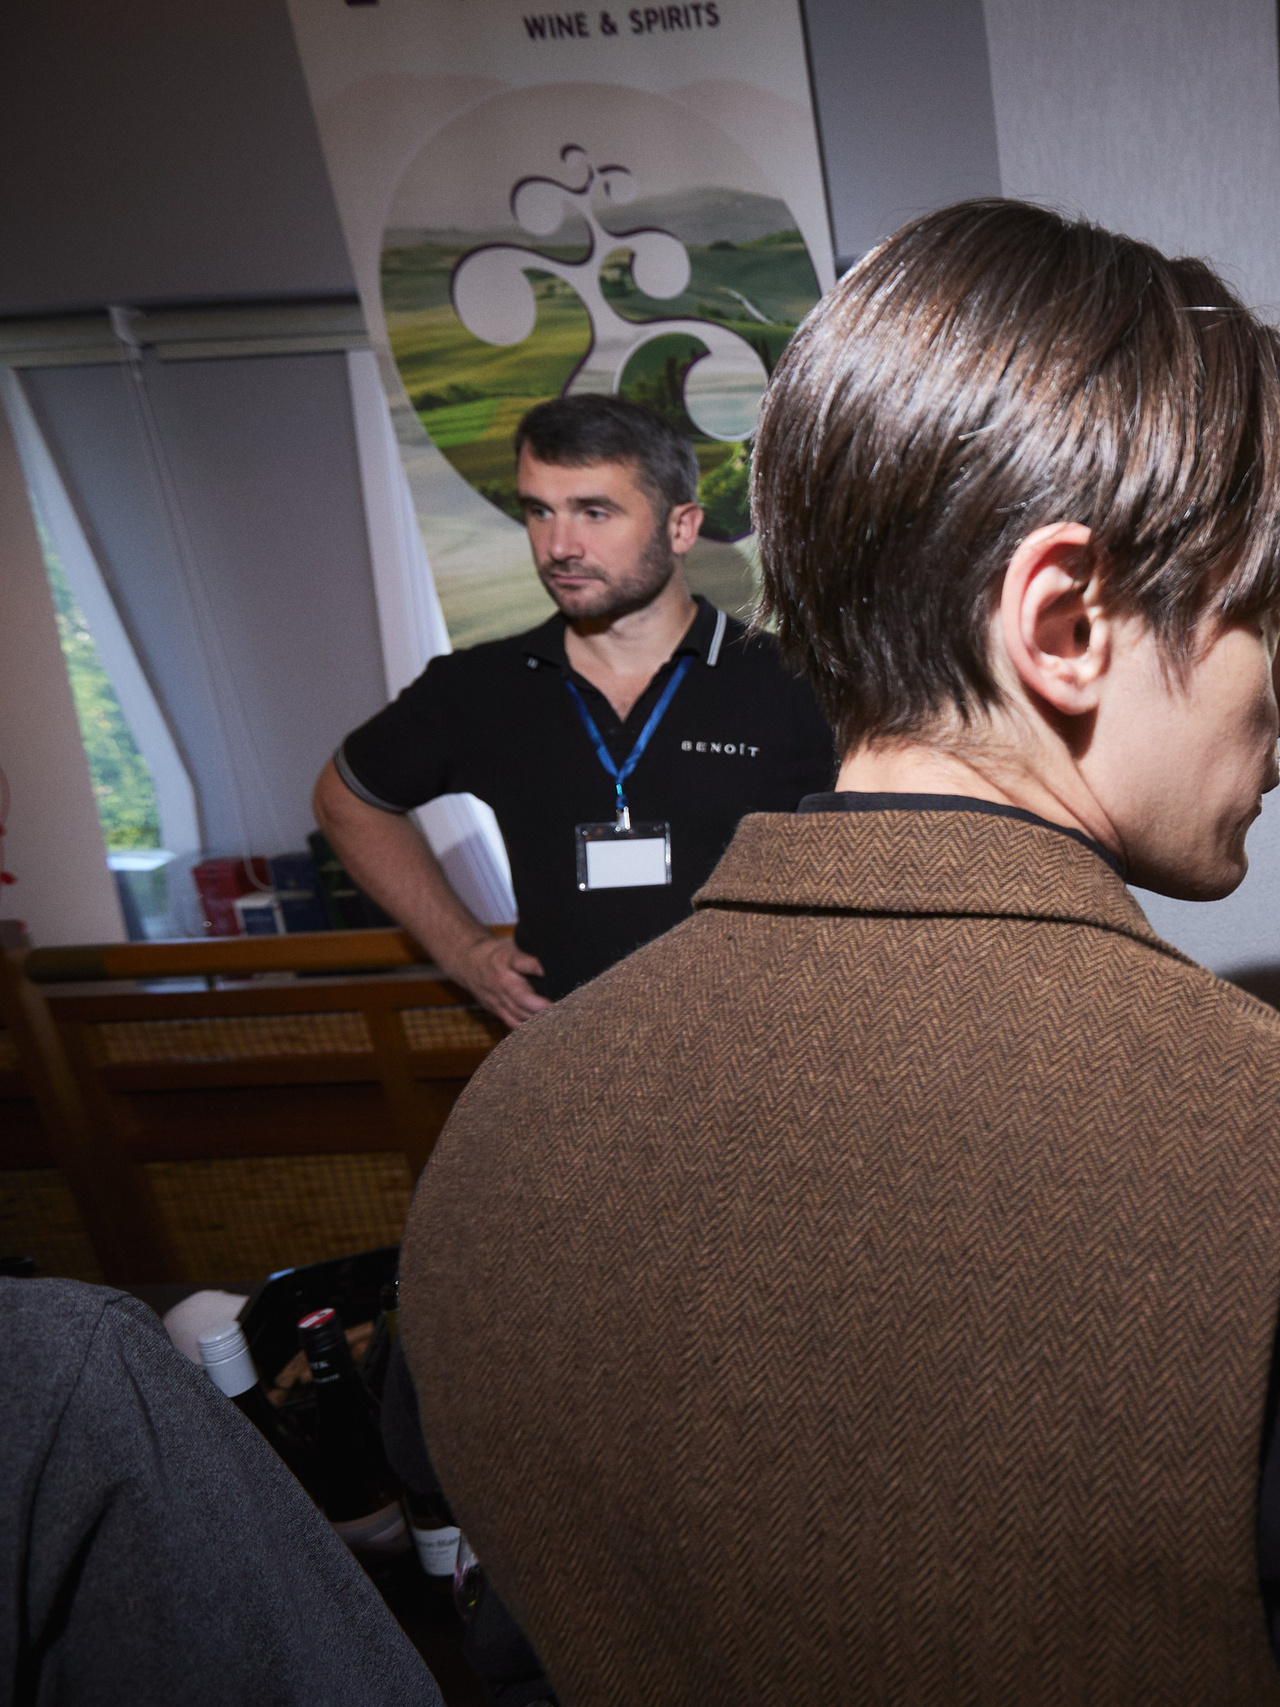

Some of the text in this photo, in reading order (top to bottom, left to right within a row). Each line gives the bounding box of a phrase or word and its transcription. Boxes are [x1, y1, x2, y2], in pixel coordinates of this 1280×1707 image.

[523, 2, 720, 40] WINE & SPIRITS
